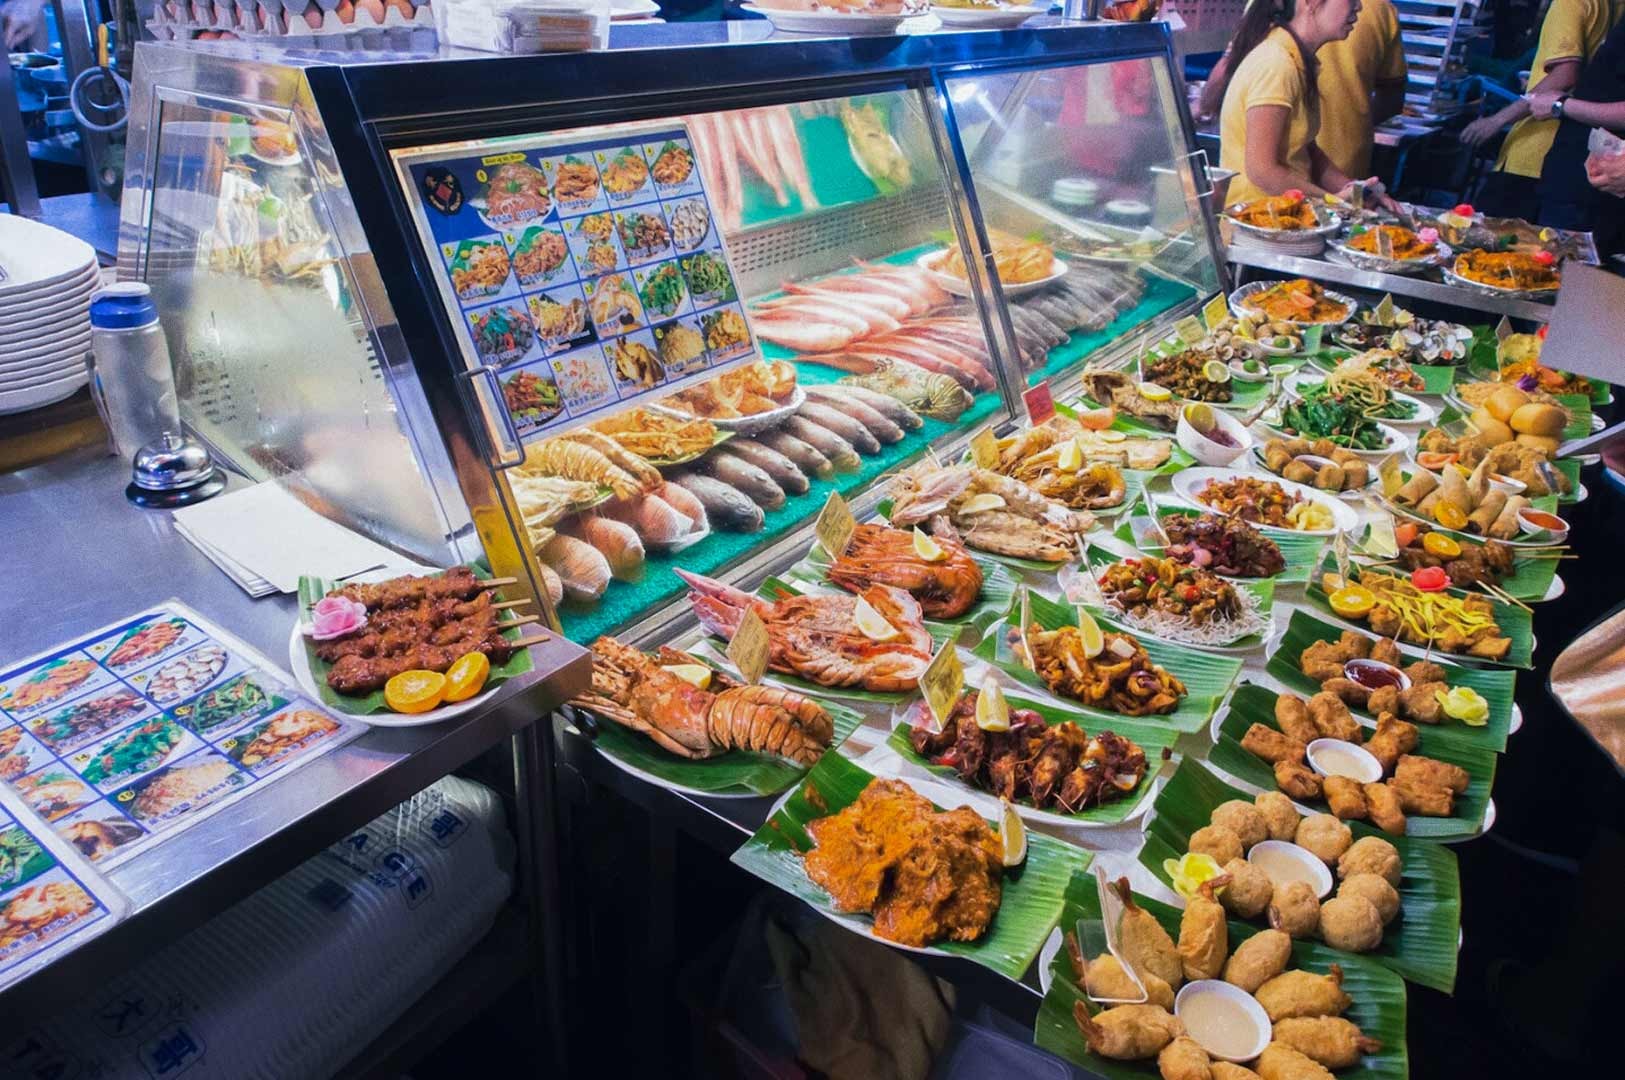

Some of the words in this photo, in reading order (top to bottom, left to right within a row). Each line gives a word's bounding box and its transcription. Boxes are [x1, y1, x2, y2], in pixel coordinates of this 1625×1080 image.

[223, 739, 237, 748] 20
[74, 754, 89, 762] 14
[120, 791, 134, 800] 19
